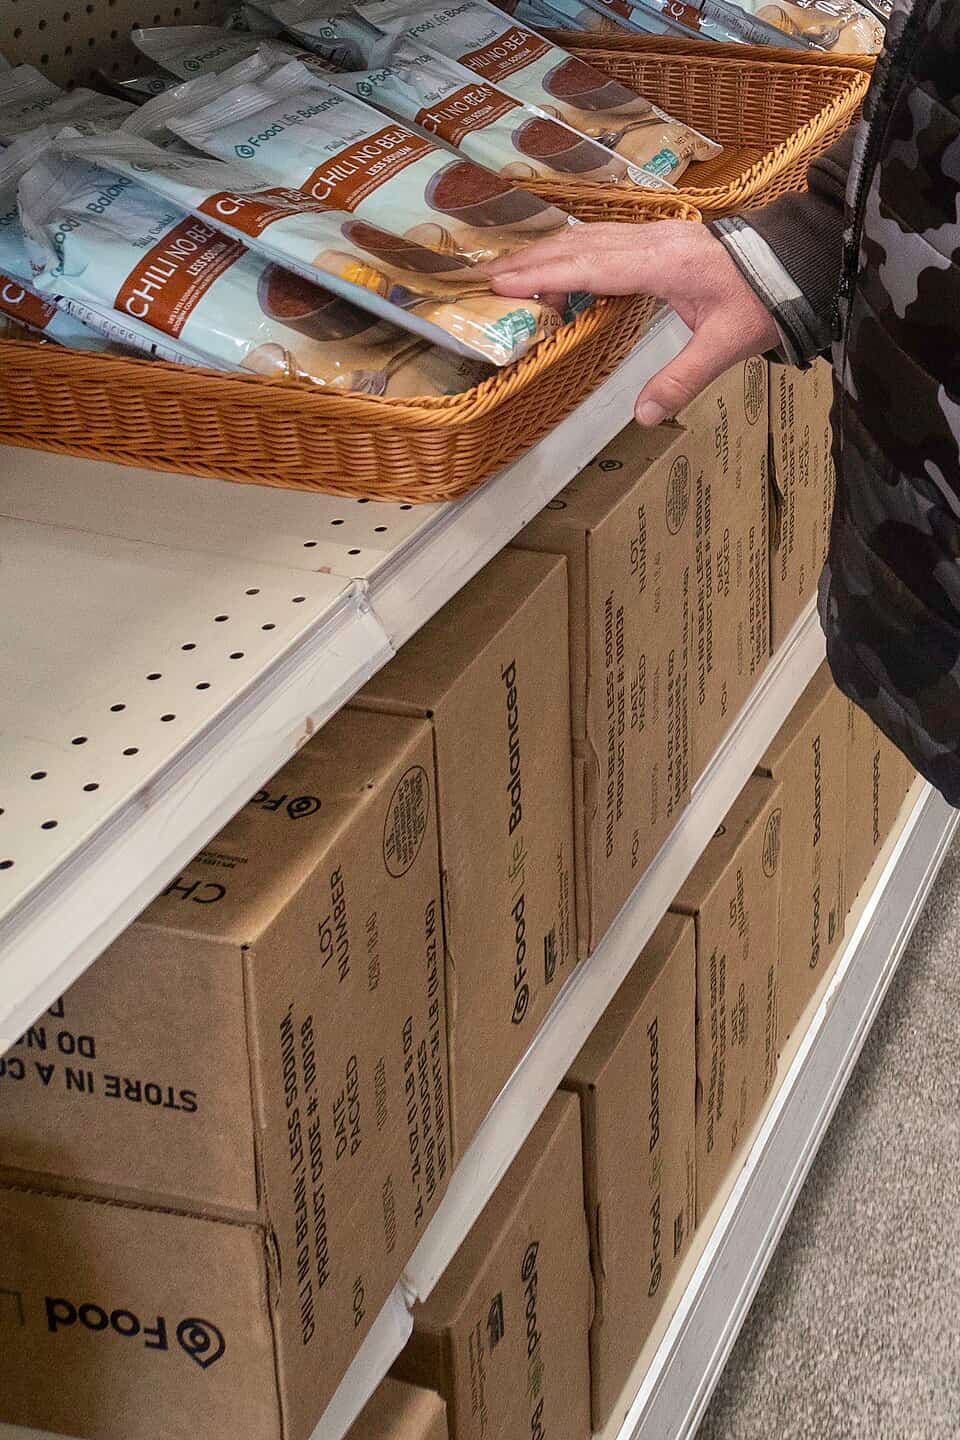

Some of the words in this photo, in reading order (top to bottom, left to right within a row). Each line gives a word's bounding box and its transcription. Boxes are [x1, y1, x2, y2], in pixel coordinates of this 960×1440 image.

[489, 45, 507, 61] NO
[505, 31, 531, 50] BEA
[248, 122, 285, 148] Food
[311, 159, 360, 201] CHILI
[353, 144, 382, 166] NO
[365, 159, 388, 176] LESS
[126, 256, 179, 318] CHILI
[164, 237, 200, 261] NO
[185, 255, 208, 276] LESS
[630, 533, 638, 577] LOT
[638, 500, 647, 593] NUMBER
[606, 668, 614, 722] LESS
[630, 674, 638, 730] DATE
[638, 651, 646, 733] PACKED
[606, 779, 614, 811] NO
[615, 736, 625, 822] PRODUCT
[606, 808, 614, 859] CHILI
[319, 910, 333, 968] LOT
[330, 859, 350, 985] NUMBER
[510, 894, 526, 990] Food
[811, 884, 821, 948] Food
[428, 995, 438, 1032] LB
[35, 1061, 55, 1086] A
[57, 1031, 96, 1059] DO
[301, 1012, 316, 1093] 100138
[65, 1066, 94, 1094] IN
[103, 1074, 198, 1113] STORE
[345, 1049, 362, 1156] PACKED
[405, 1069, 415, 1106] LB
[417, 1034, 431, 1140] POUCHES
[432, 1053, 444, 1139] WEIGHT
[647, 1015, 661, 1154] Balanced
[287, 1104, 302, 1175] LESS
[309, 1115, 322, 1184] CODE
[333, 1088, 347, 1161] DATE
[409, 1121, 418, 1157] OZ
[411, 1151, 420, 1185] 24
[312, 1179, 329, 1289] PRODUCT
[413, 1194, 423, 1231] 24
[649, 1194, 662, 1269] Food
[297, 1241, 309, 1285] NO
[45, 1296, 168, 1350] Food
[300, 1277, 314, 1347] CHILI
[524, 1270, 542, 1360] Food
